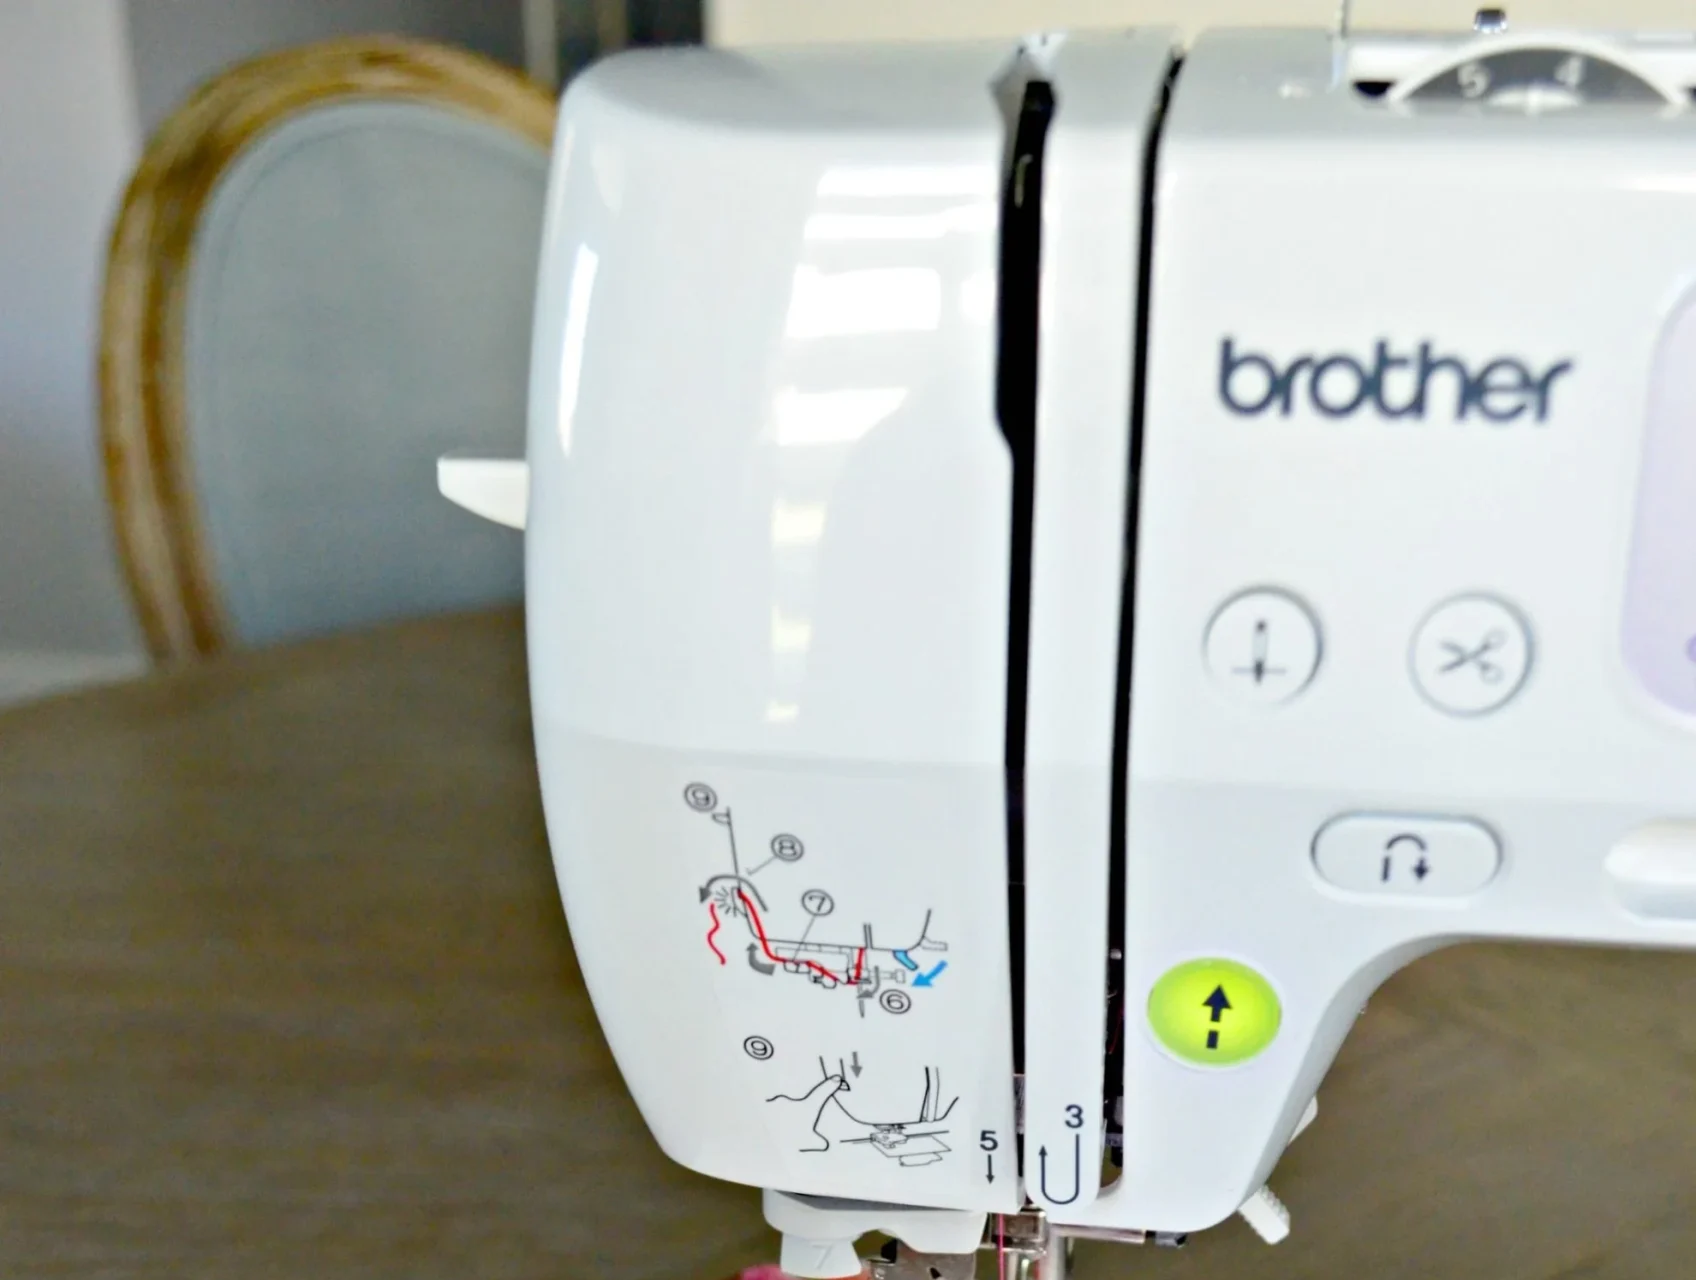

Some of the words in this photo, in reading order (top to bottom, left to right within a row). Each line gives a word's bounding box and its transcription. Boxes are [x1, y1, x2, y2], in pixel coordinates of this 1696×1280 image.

[1218, 336, 1574, 424] brother
[1064, 1104, 1084, 1129] 3
[979, 1130, 999, 1151] 5
